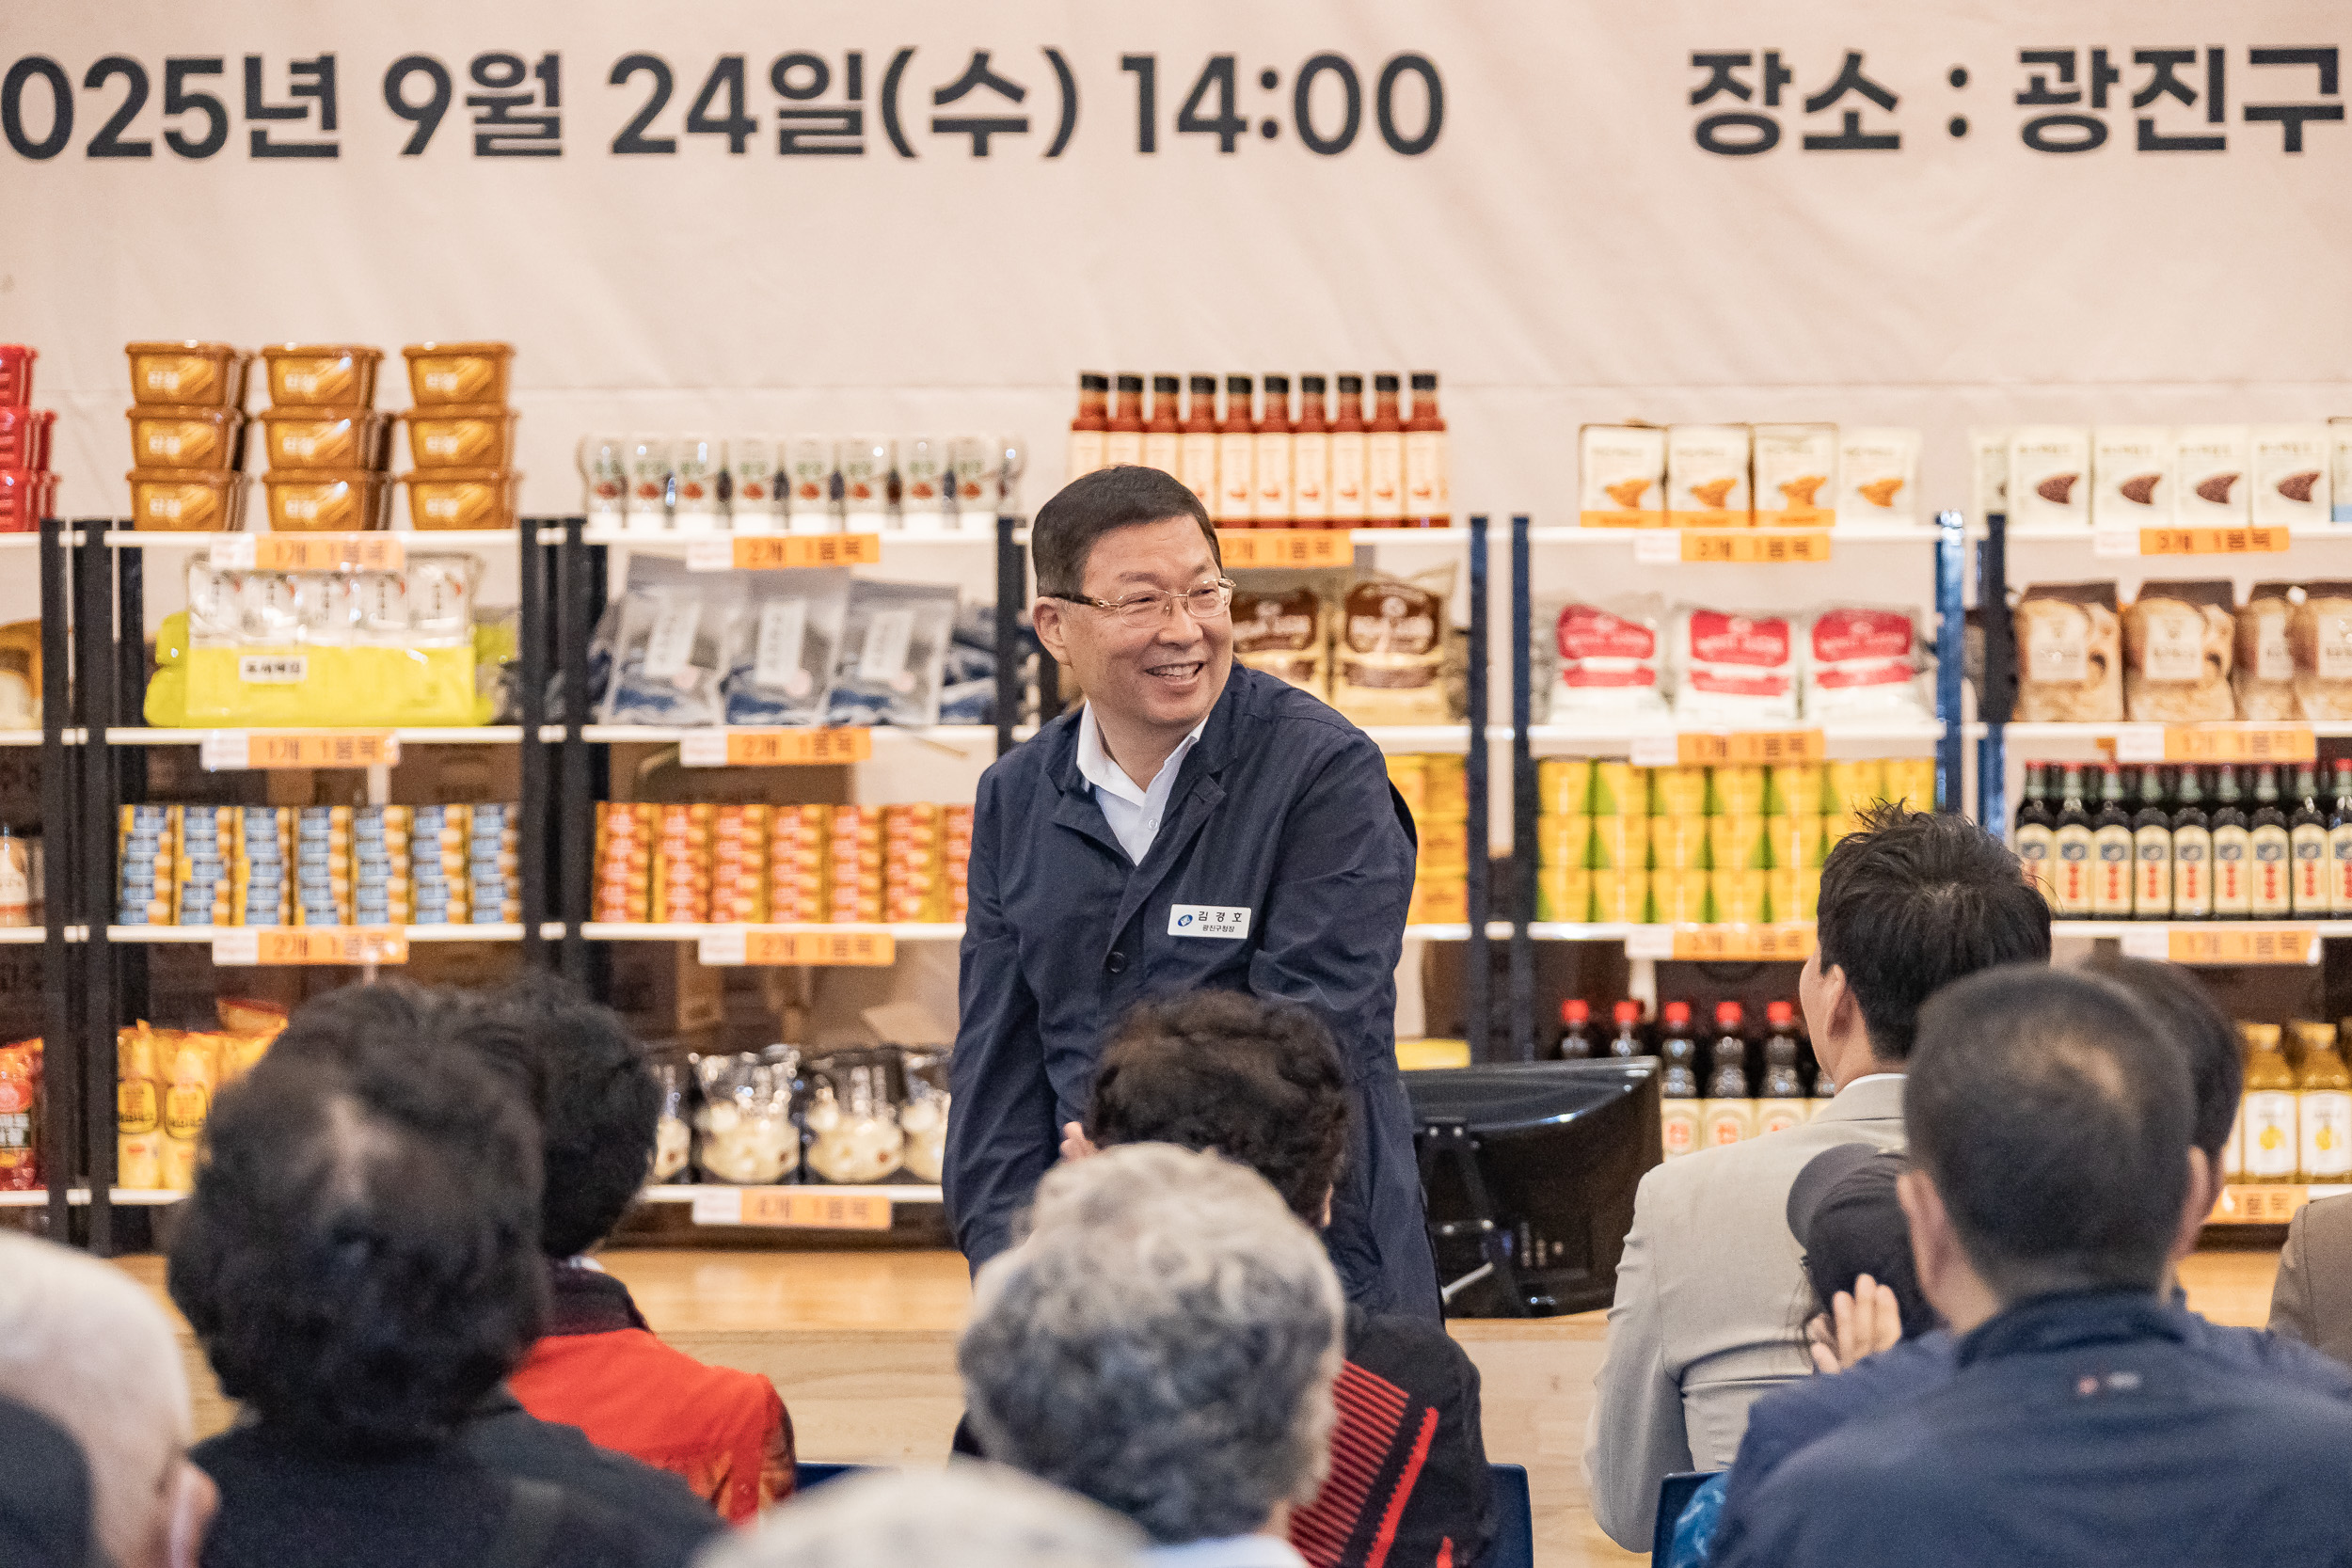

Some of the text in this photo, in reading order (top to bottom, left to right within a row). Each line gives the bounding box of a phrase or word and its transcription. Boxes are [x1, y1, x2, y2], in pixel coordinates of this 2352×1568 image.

[0, 47, 1445, 161] 025년 9월 24일(수) 14:00
[1689, 51, 1901, 157] 장소
[2015, 46, 2346, 154] 광진구
